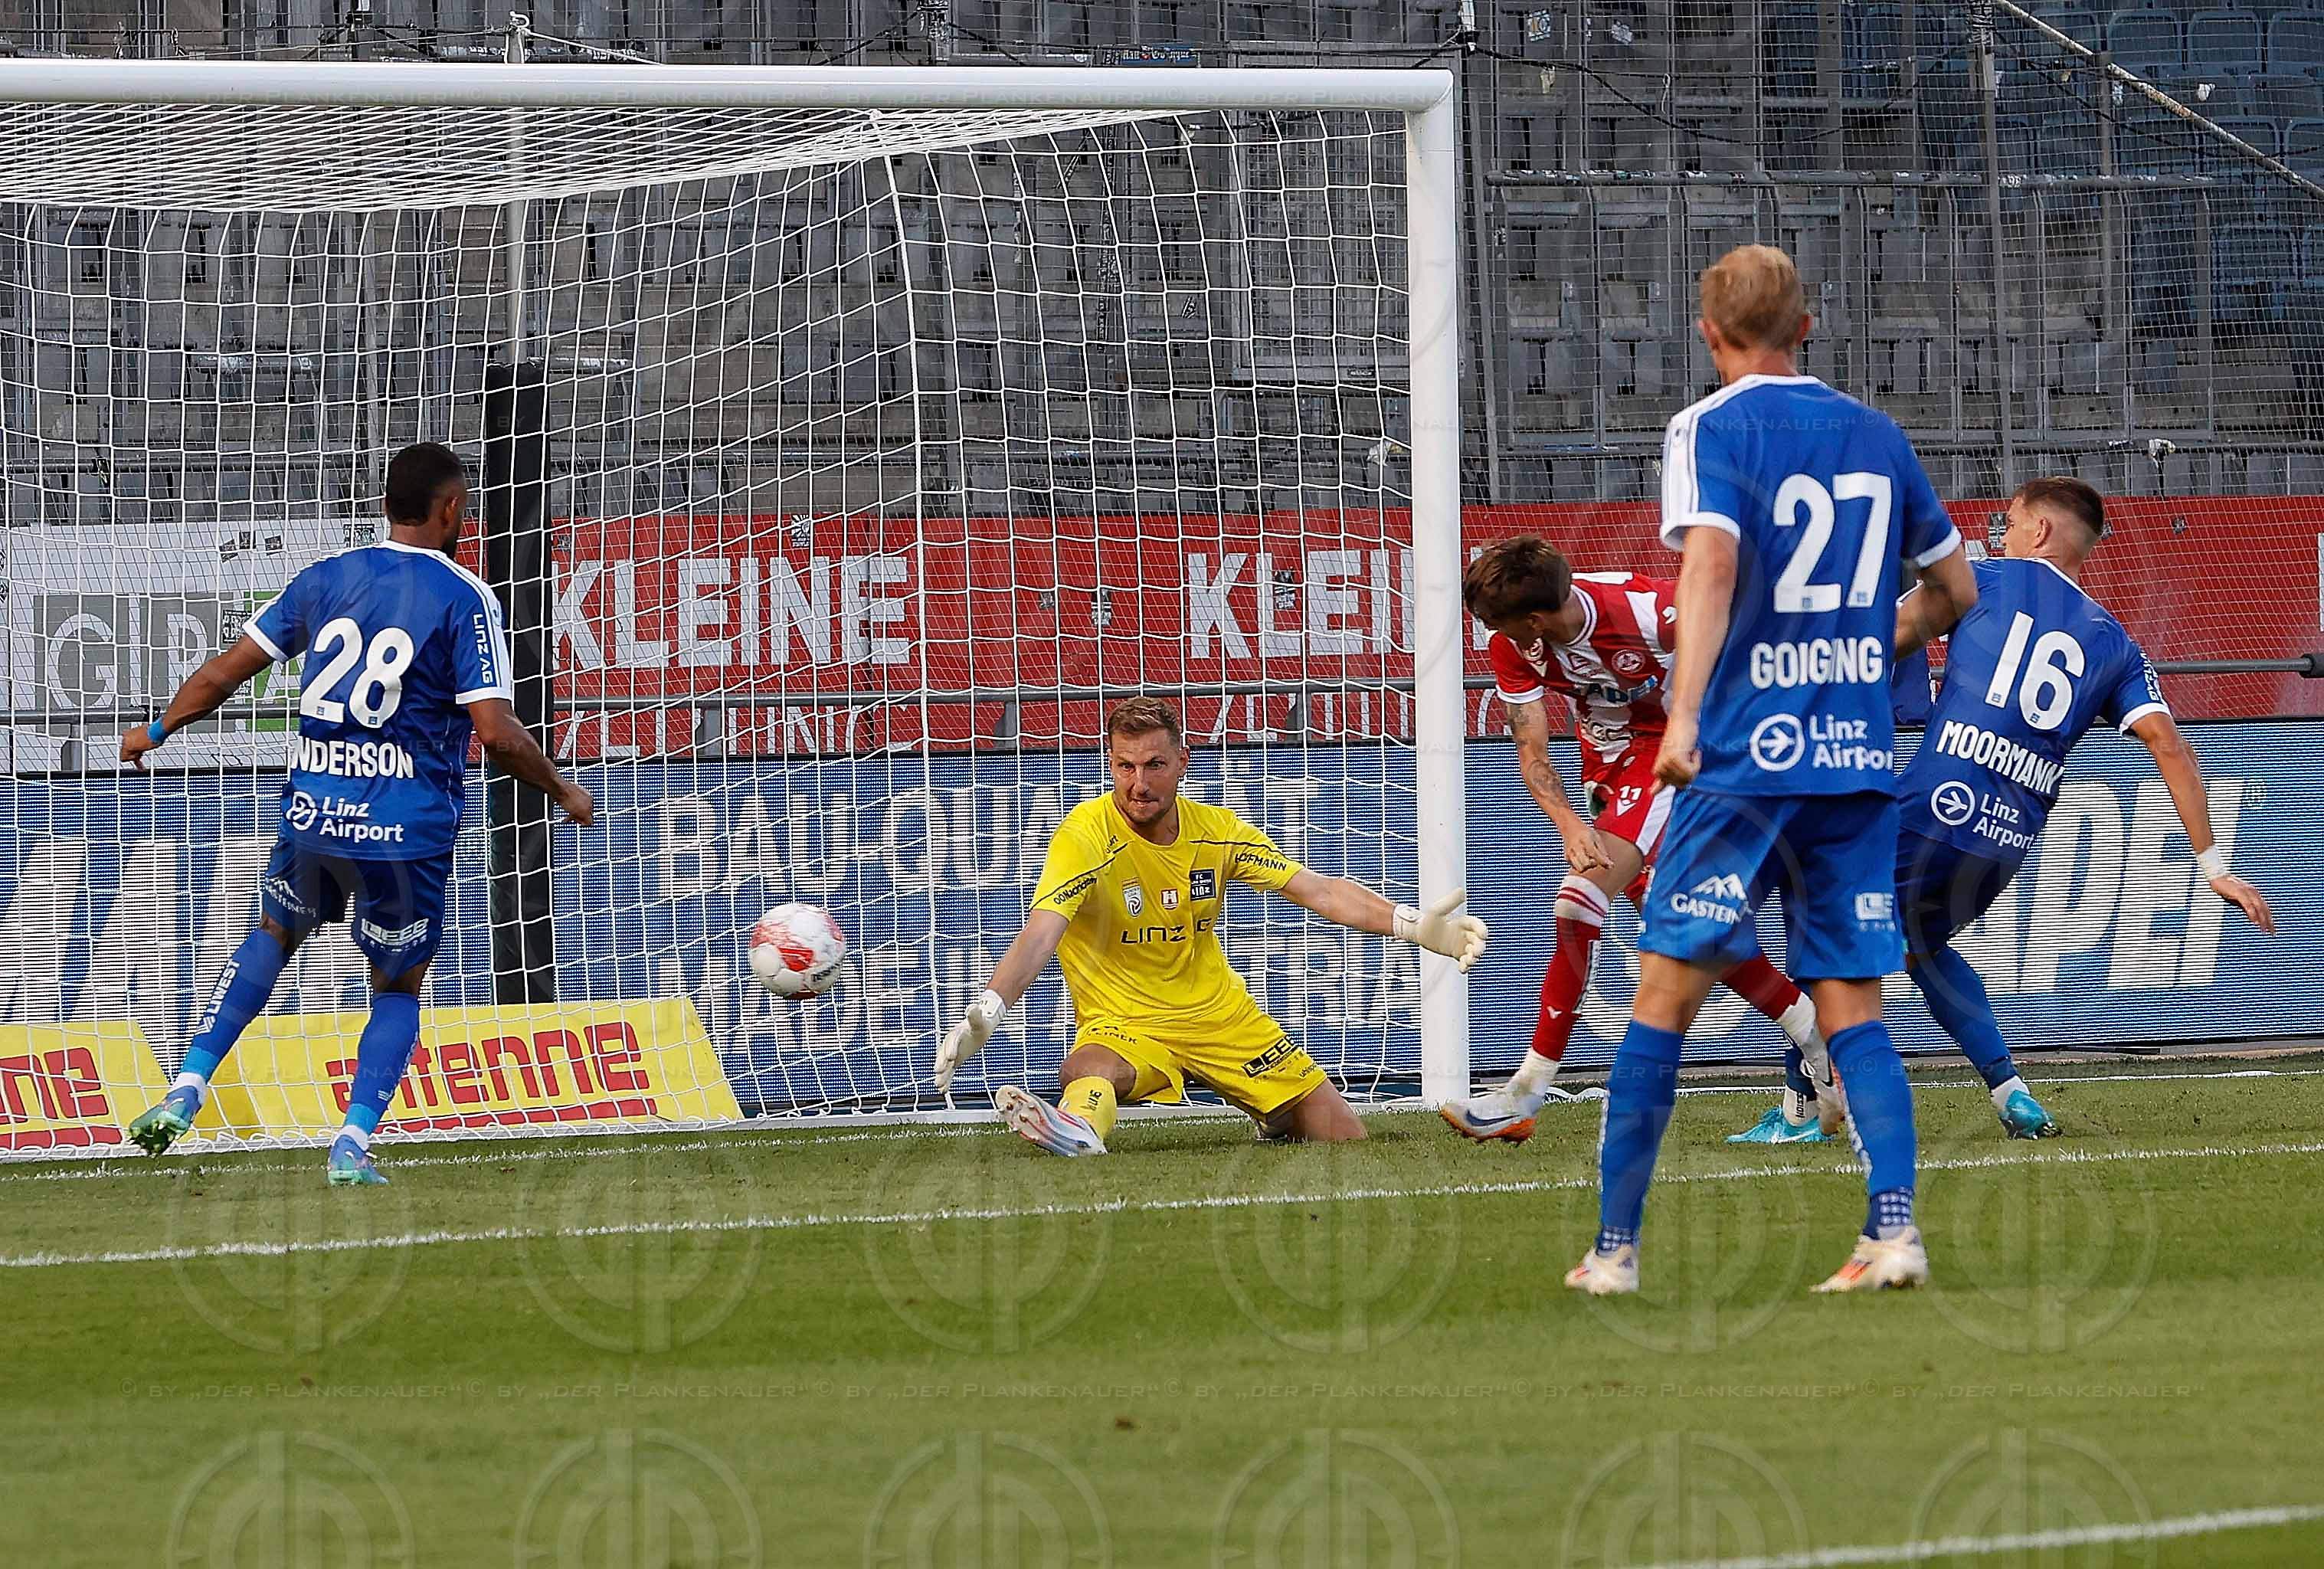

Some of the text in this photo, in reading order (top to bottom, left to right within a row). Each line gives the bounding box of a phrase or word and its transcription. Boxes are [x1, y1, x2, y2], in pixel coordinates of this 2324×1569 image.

[1773, 472, 1892, 613] 27
[552, 557, 910, 670] KLEINE
[1188, 548, 1416, 660] KLEI
[300, 617, 414, 729] 28
[472, 613, 494, 684] LINZ AG
[1985, 611, 2085, 730] 16
[1809, 713, 1868, 742] Linz
[1936, 719, 2067, 794] MOORMANN
[322, 796, 371, 817] Linz
[1619, 785, 1643, 801] 11
[1979, 794, 2021, 824] Linz
[319, 817, 404, 843] Airport
[1972, 816, 2035, 850] Airport
[206, 958, 241, 1015] LIWEST
